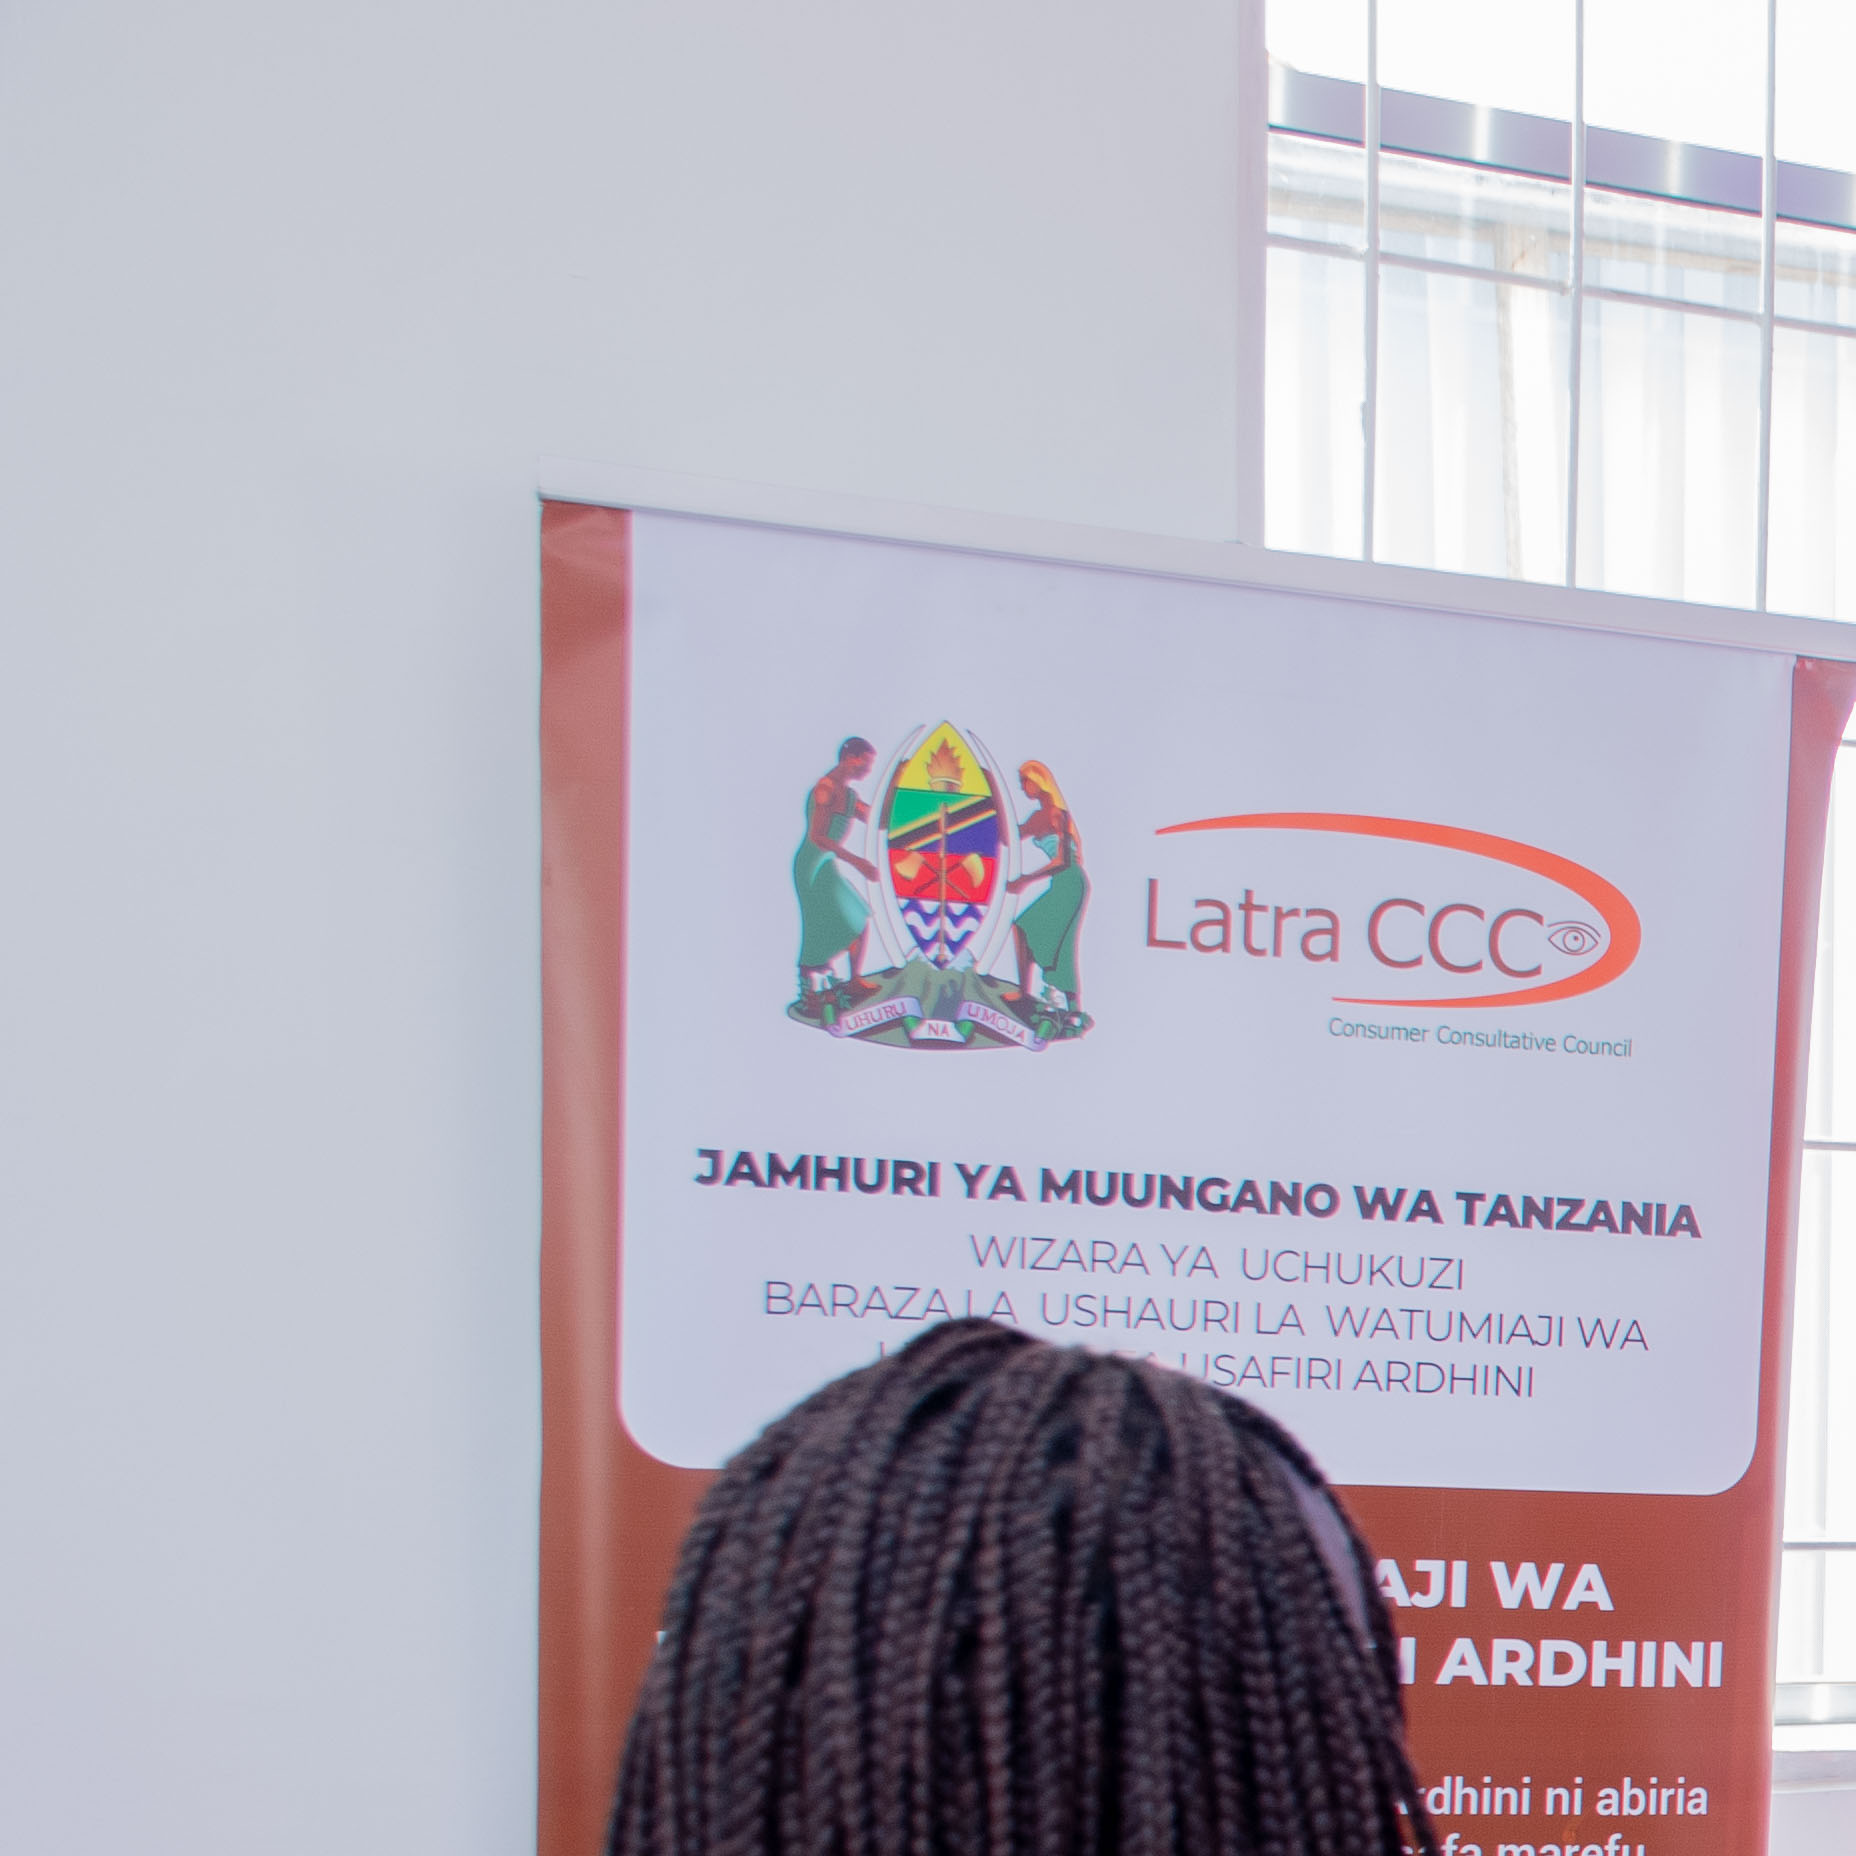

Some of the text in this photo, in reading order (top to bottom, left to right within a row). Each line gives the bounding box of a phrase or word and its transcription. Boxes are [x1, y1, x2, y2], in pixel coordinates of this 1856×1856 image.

[1146, 878, 1544, 978] Latra CCC
[848, 1002, 1027, 1042] UHURU NA UMOJA
[1329, 1017, 1632, 1058] Consumer Consultative Council
[695, 1148, 1702, 1239] JAMHURI YA MUUNGANO WA TANZANIA
[970, 1234, 1464, 1290] WIZARA YA UCHUKUZI
[764, 1280, 952, 1320] BARAZA
[1042, 1292, 1239, 1333] USHAURI
[1256, 1302, 1305, 1336] LA
[1325, 1304, 1564, 1347] WATUMIAJI
[1577, 1316, 1649, 1351] WA
[1353, 1360, 1534, 1398] ARDHINI
[1375, 1558, 1614, 1611] AJI WA
[1435, 1637, 1723, 1687] ARDHINI
[1545, 1777, 1583, 1815] ni
[1596, 1776, 1709, 1816] abiria
